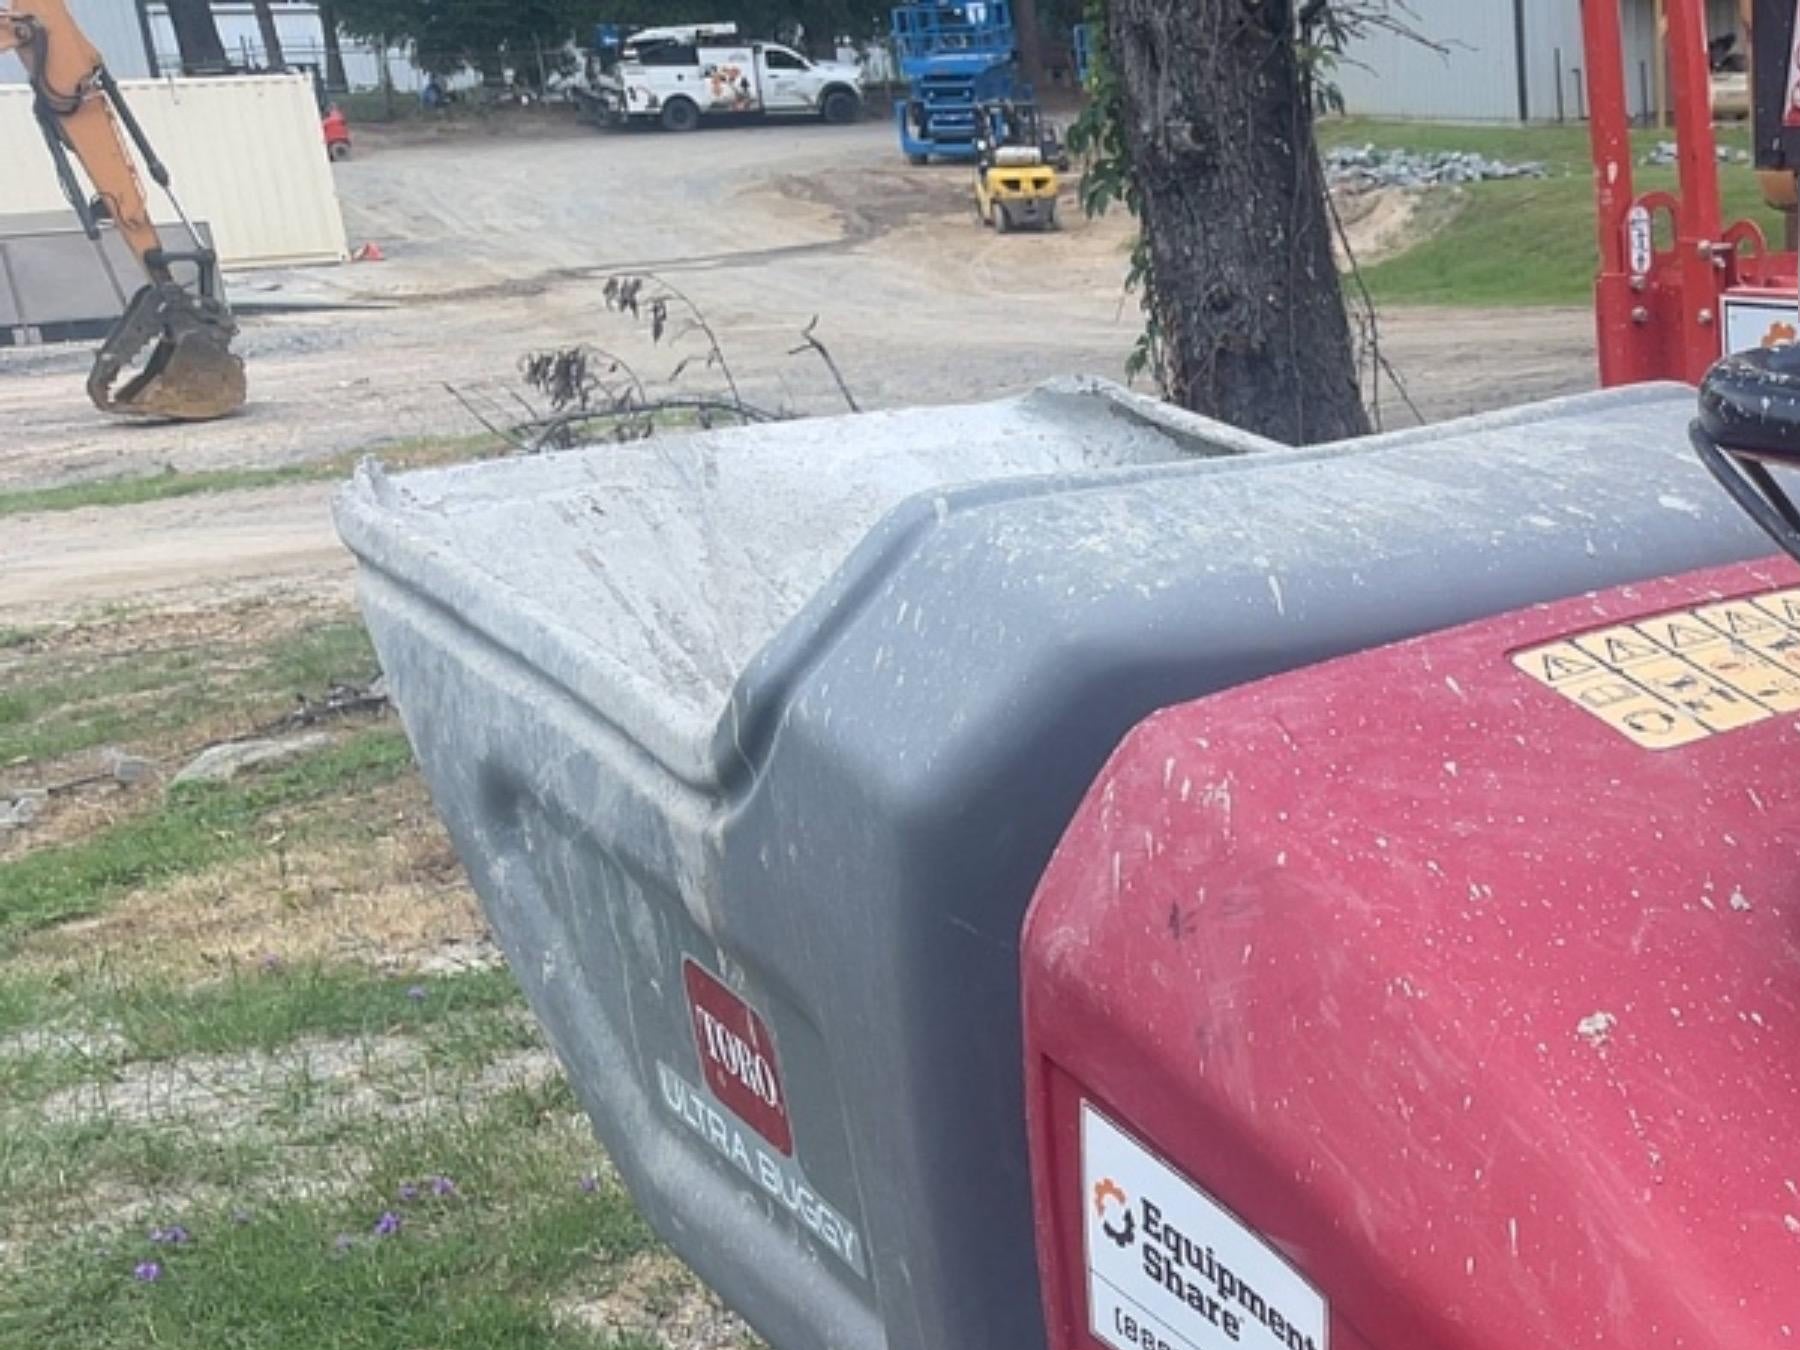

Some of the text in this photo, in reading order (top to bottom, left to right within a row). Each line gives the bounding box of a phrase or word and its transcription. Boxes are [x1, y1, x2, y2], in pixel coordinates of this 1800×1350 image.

[695, 1003, 779, 1107] TORO
[656, 1058, 755, 1176] ULTRA
[1141, 1243, 1241, 1343] Share
